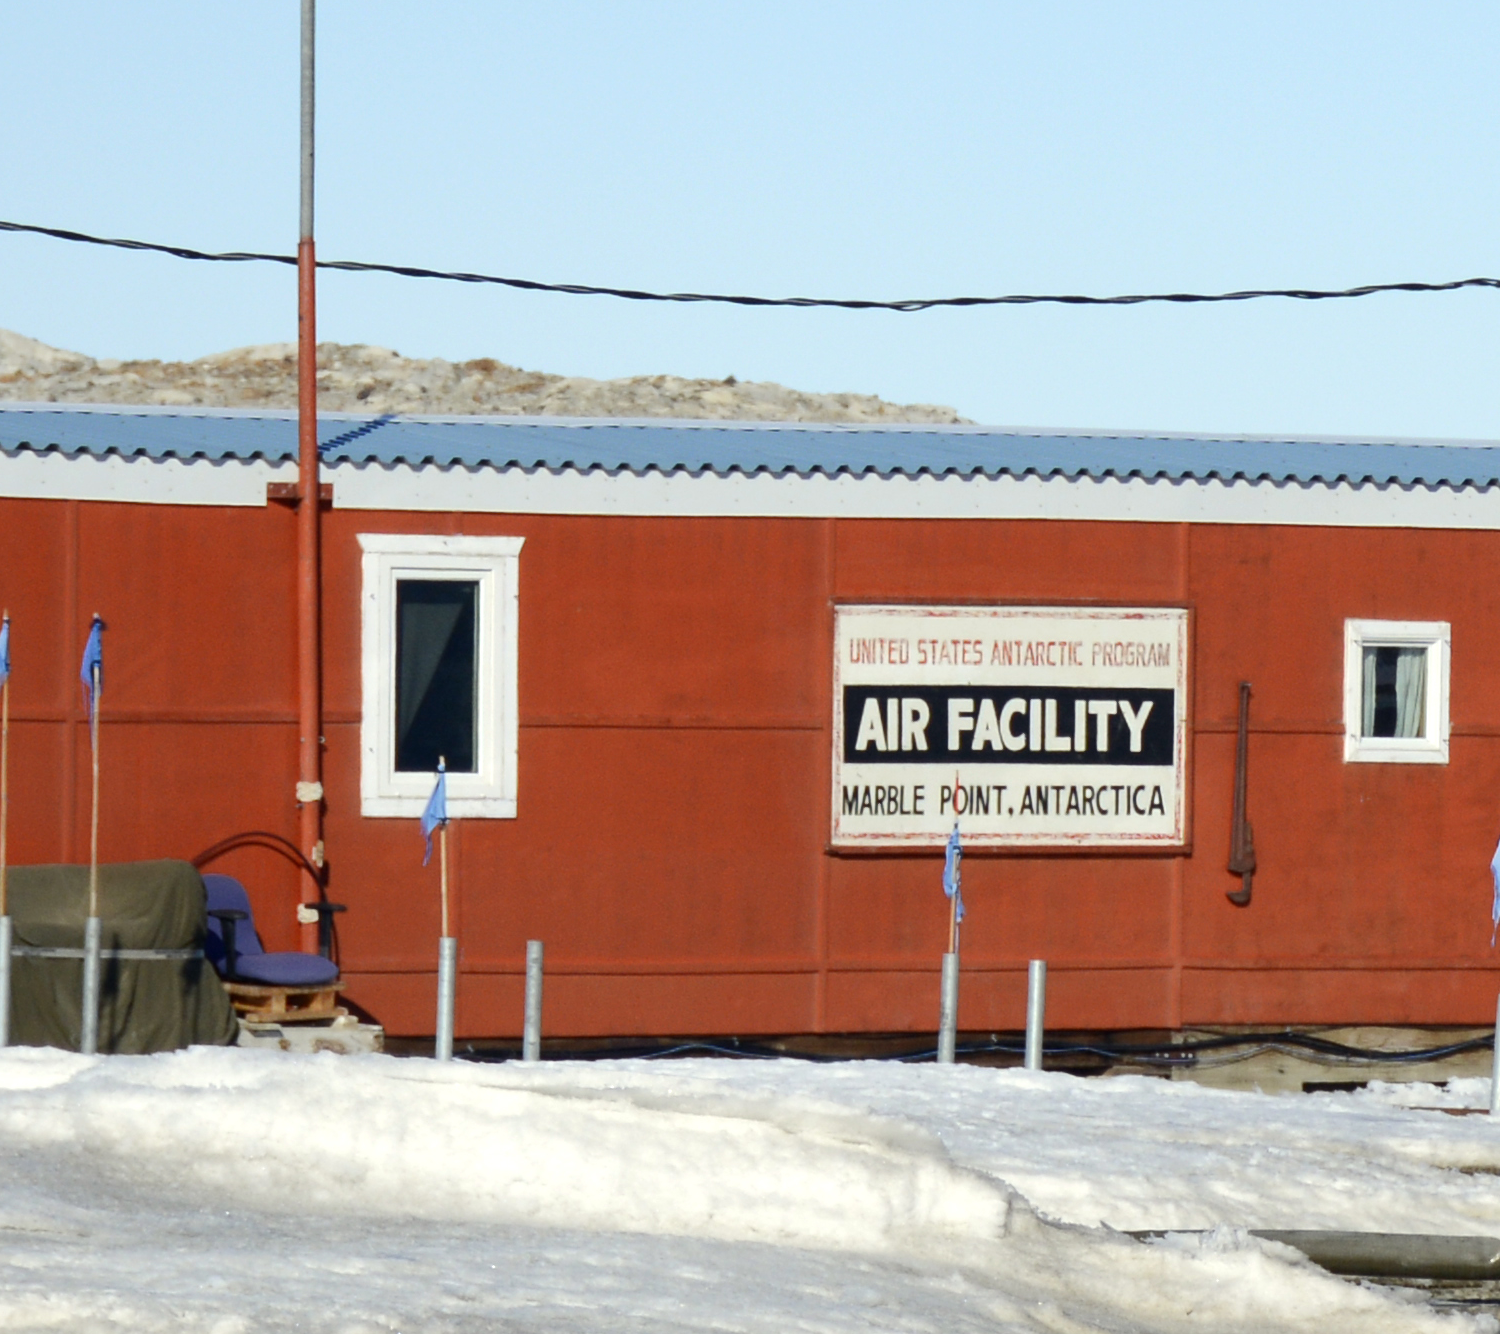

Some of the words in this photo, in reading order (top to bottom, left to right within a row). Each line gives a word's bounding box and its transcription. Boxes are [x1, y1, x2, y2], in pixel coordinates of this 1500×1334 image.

[849, 637, 910, 665] UNITED
[917, 638, 983, 665] STATES
[990, 640, 1083, 666] ANTARCTIC
[1091, 641, 1171, 667] PROGRAM
[855, 697, 930, 751] AIR
[947, 697, 1154, 753] FACILITY
[842, 784, 925, 815] MARBLE
[940, 784, 1015, 818] POINT,
[1019, 784, 1166, 816] ANTARCTICA
